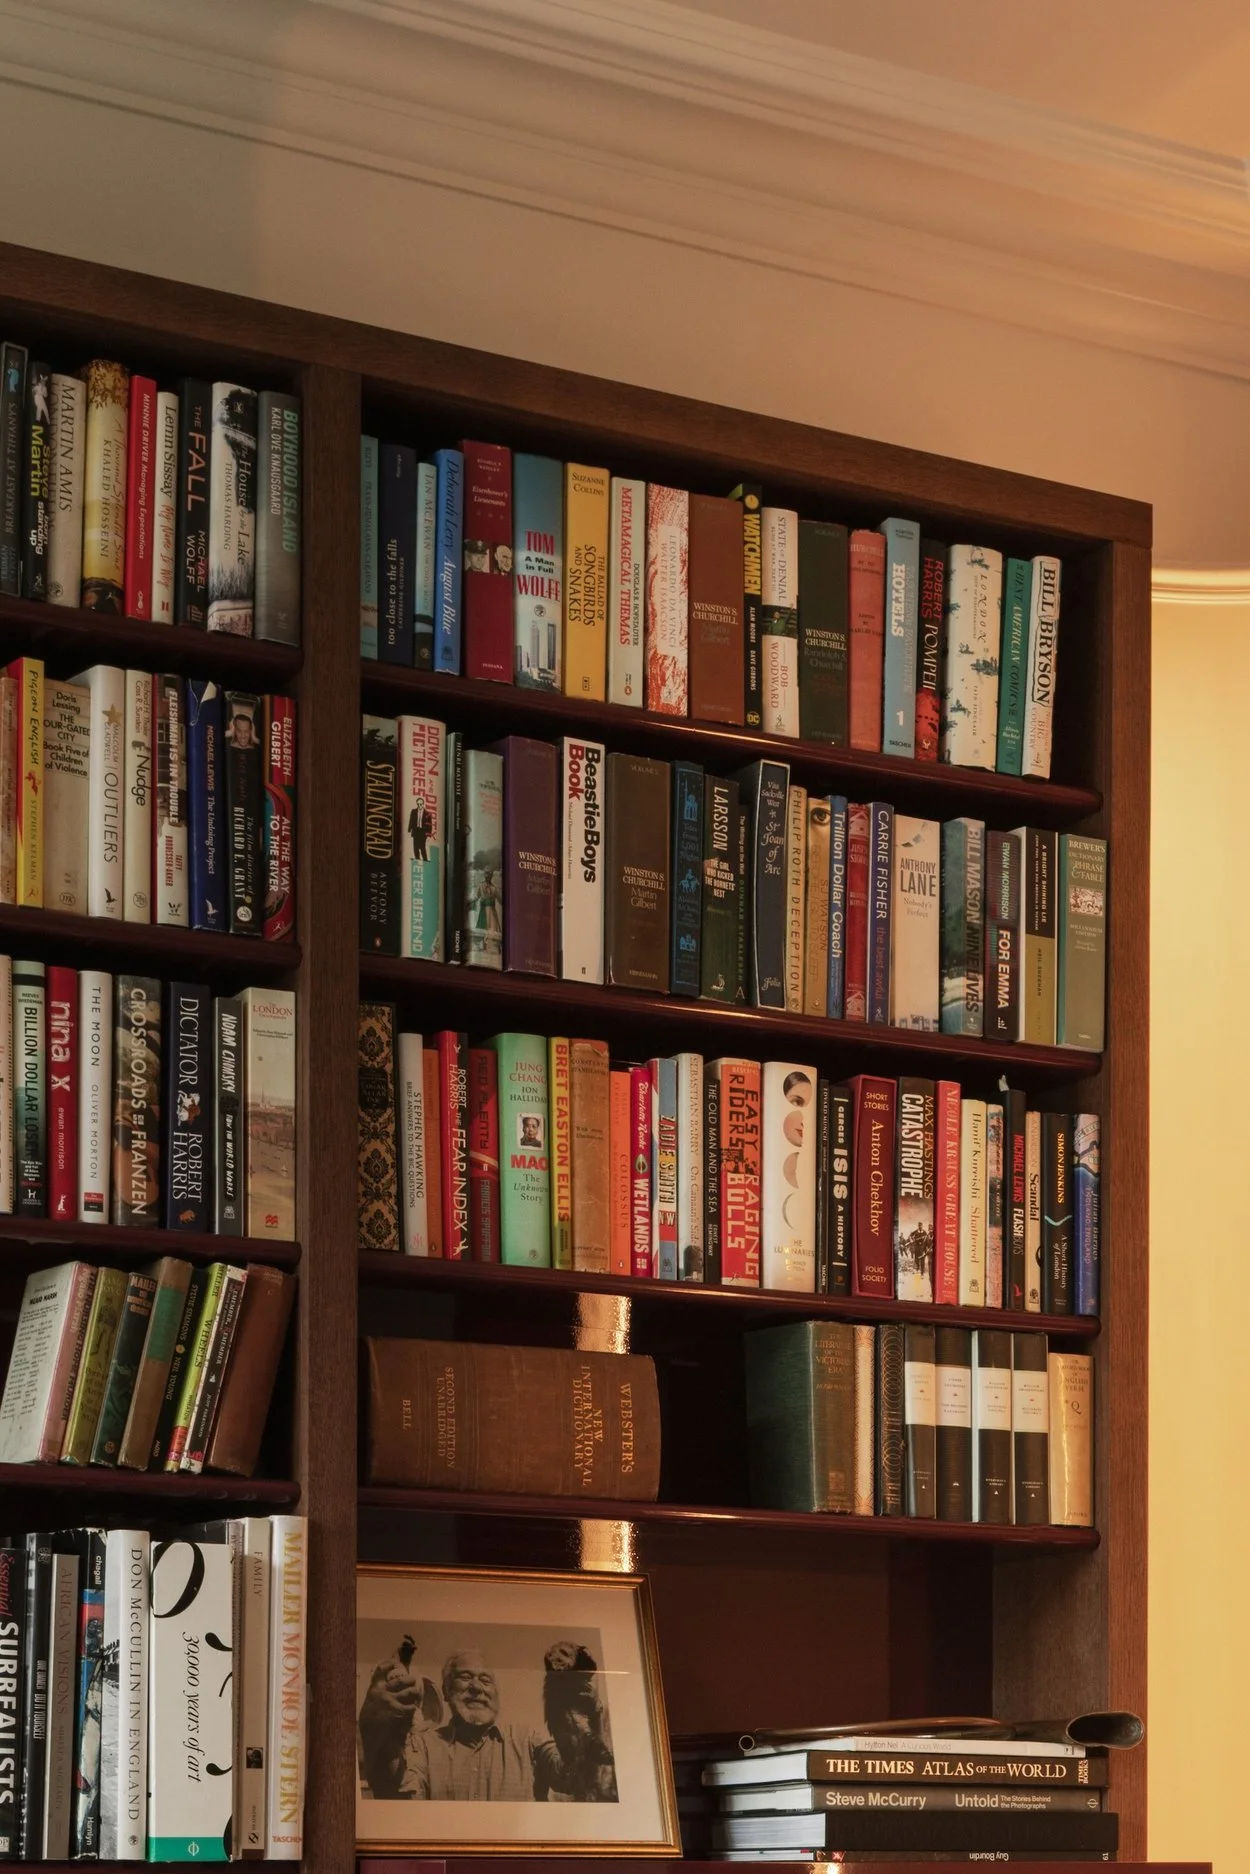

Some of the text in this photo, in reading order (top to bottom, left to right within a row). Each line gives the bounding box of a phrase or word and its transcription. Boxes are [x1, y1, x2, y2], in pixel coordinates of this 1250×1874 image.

[31, 425, 45, 497] Martin
[59, 384, 76, 512] MARTIN AMIS
[160, 406, 176, 499] Lemn Sissay
[187, 431, 206, 511] FALL
[282, 410, 298, 553] BOYHOOD ISLAND
[100, 439, 112, 558] KHALED HOSSEINI
[270, 453, 281, 515] KNAUSGAARD
[186, 535, 196, 585] WOLFF
[525, 530, 555, 556] TOM
[619, 487, 633, 646] METAMAGICAL THEMAS
[669, 535, 677, 594] LEONARDO
[743, 513, 761, 596] WATCHMEN
[777, 516, 788, 602] STATE DENIAL
[387, 538, 398, 625] close falls
[569, 568, 582, 622] SNAKES
[583, 545, 597, 627] SONGBIRDS
[659, 543, 668, 641] WALTER ISAACSON
[922, 556, 935, 618] HARRIS
[932, 559, 944, 619] ROBERT
[922, 623, 938, 691] POMPEII
[1036, 568, 1056, 704] BILL BRYSON
[52, 701, 81, 715] Lessing
[56, 691, 77, 703] Doris
[770, 642, 779, 709] WOODWARD
[780, 665, 788, 688] BOB
[57, 731, 75, 743] CITY
[59, 714, 75, 724] THE
[65, 744, 82, 757] Five
[270, 720, 282, 768] GILBERT
[282, 716, 293, 777] ELIZABETH
[427, 726, 440, 777] DOWN
[896, 711, 905, 727] 1
[50, 752, 84, 767] Children
[54, 763, 88, 777] Violence
[131, 754, 151, 808] Nudge
[411, 723, 426, 798] PICTURES
[568, 743, 584, 800] Book
[104, 772, 119, 864] OUTLIERS
[366, 760, 395, 861] STALINGRAD
[712, 785, 729, 852] LARSSON
[379, 872, 387, 925] ANTONY
[831, 812, 846, 958] Trillion Dollar Coach
[875, 810, 889, 919] CARRIE FISHER
[900, 858, 937, 874] ANTHONY
[900, 871, 937, 898] LANE
[1000, 842, 1011, 920] EWAN MORRISON
[789, 897, 801, 992] DECEPTION
[997, 929, 1011, 1009] FOR EMMA
[24, 1006, 38, 1112] BILLION DOLLAR
[51, 1002, 74, 1063] nina
[178, 996, 200, 1086] DICTATOR
[221, 1013, 238, 1046] NOAM
[89, 986, 101, 1179] THE MOON MORTON
[130, 987, 148, 1215] CROSSROADS FRANZEN
[457, 1068, 467, 1109] ROBERT
[863, 1101, 890, 1111] STORIES
[865, 1092, 889, 1101] SHORT
[555, 1043, 569, 1224] BRET EASTON ELLIS
[744, 1090, 759, 1151] EASY
[901, 1093, 924, 1198] CATASTROPHE
[172, 1131, 187, 1200] HARRIS
[187, 1131, 203, 1203] ROBERT
[414, 1144, 425, 1199] HAWKING
[452, 1128, 469, 1232] FEAR INDEX
[510, 1154, 549, 1172] MAO
[523, 1173, 540, 1183] The
[870, 1119, 884, 1236] Anton Chekhov
[1057, 1132, 1065, 1204] SIMON JENKINS
[633, 1178, 650, 1254] WETLANDS
[727, 1172, 745, 1250] BULLS
[744, 1173, 760, 1276] RAGING
[581, 1365, 594, 1486] INTERNATIONAL
[593, 1408, 604, 1443] NEW
[620, 1383, 635, 1473] WEBSTER'S
[58, 1567, 73, 1717] AFRICAN VISIONS
[127, 1548, 143, 1821] DON McCULLIN IN ENGLAND
[184, 1690, 200, 1735] years
[279, 1532, 302, 1826] MAILER MONROE STERN
[187, 1761, 202, 1784] art
[826, 1758, 1067, 1779] THE TIMES ATLAS OF THE WORLD
[826, 1792, 999, 1810] Steve McCurry Untold
